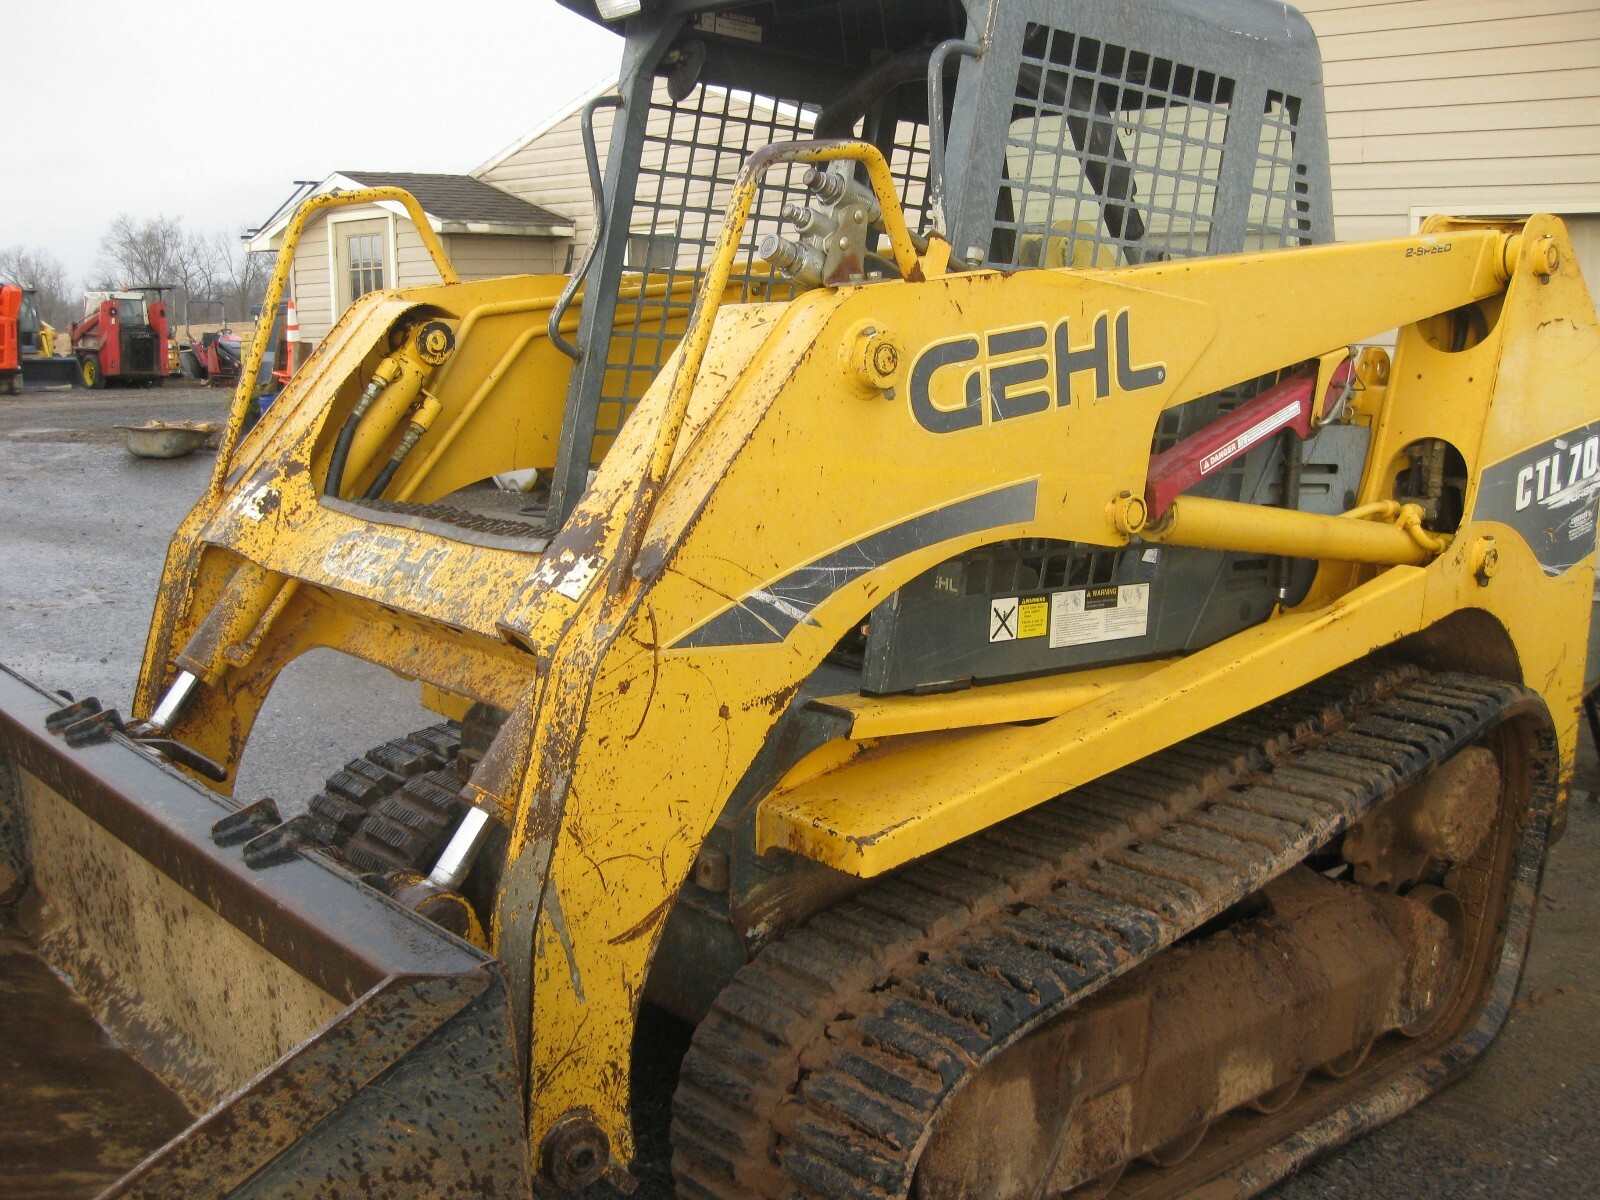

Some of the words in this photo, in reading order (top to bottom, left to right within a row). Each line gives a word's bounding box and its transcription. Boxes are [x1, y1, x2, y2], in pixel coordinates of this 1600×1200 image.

[729, 12, 756, 24] DANGER
[1405, 243, 1452, 258] 2-SPEED
[908, 308, 1167, 435] GEHL
[1210, 442, 1237, 466] DANGER
[1515, 453, 1563, 512] CTL
[1568, 435, 1599, 487] 70
[322, 527, 453, 604] GEHL
[1025, 596, 1046, 604] WARNING
[1092, 587, 1118, 598] WARNING
